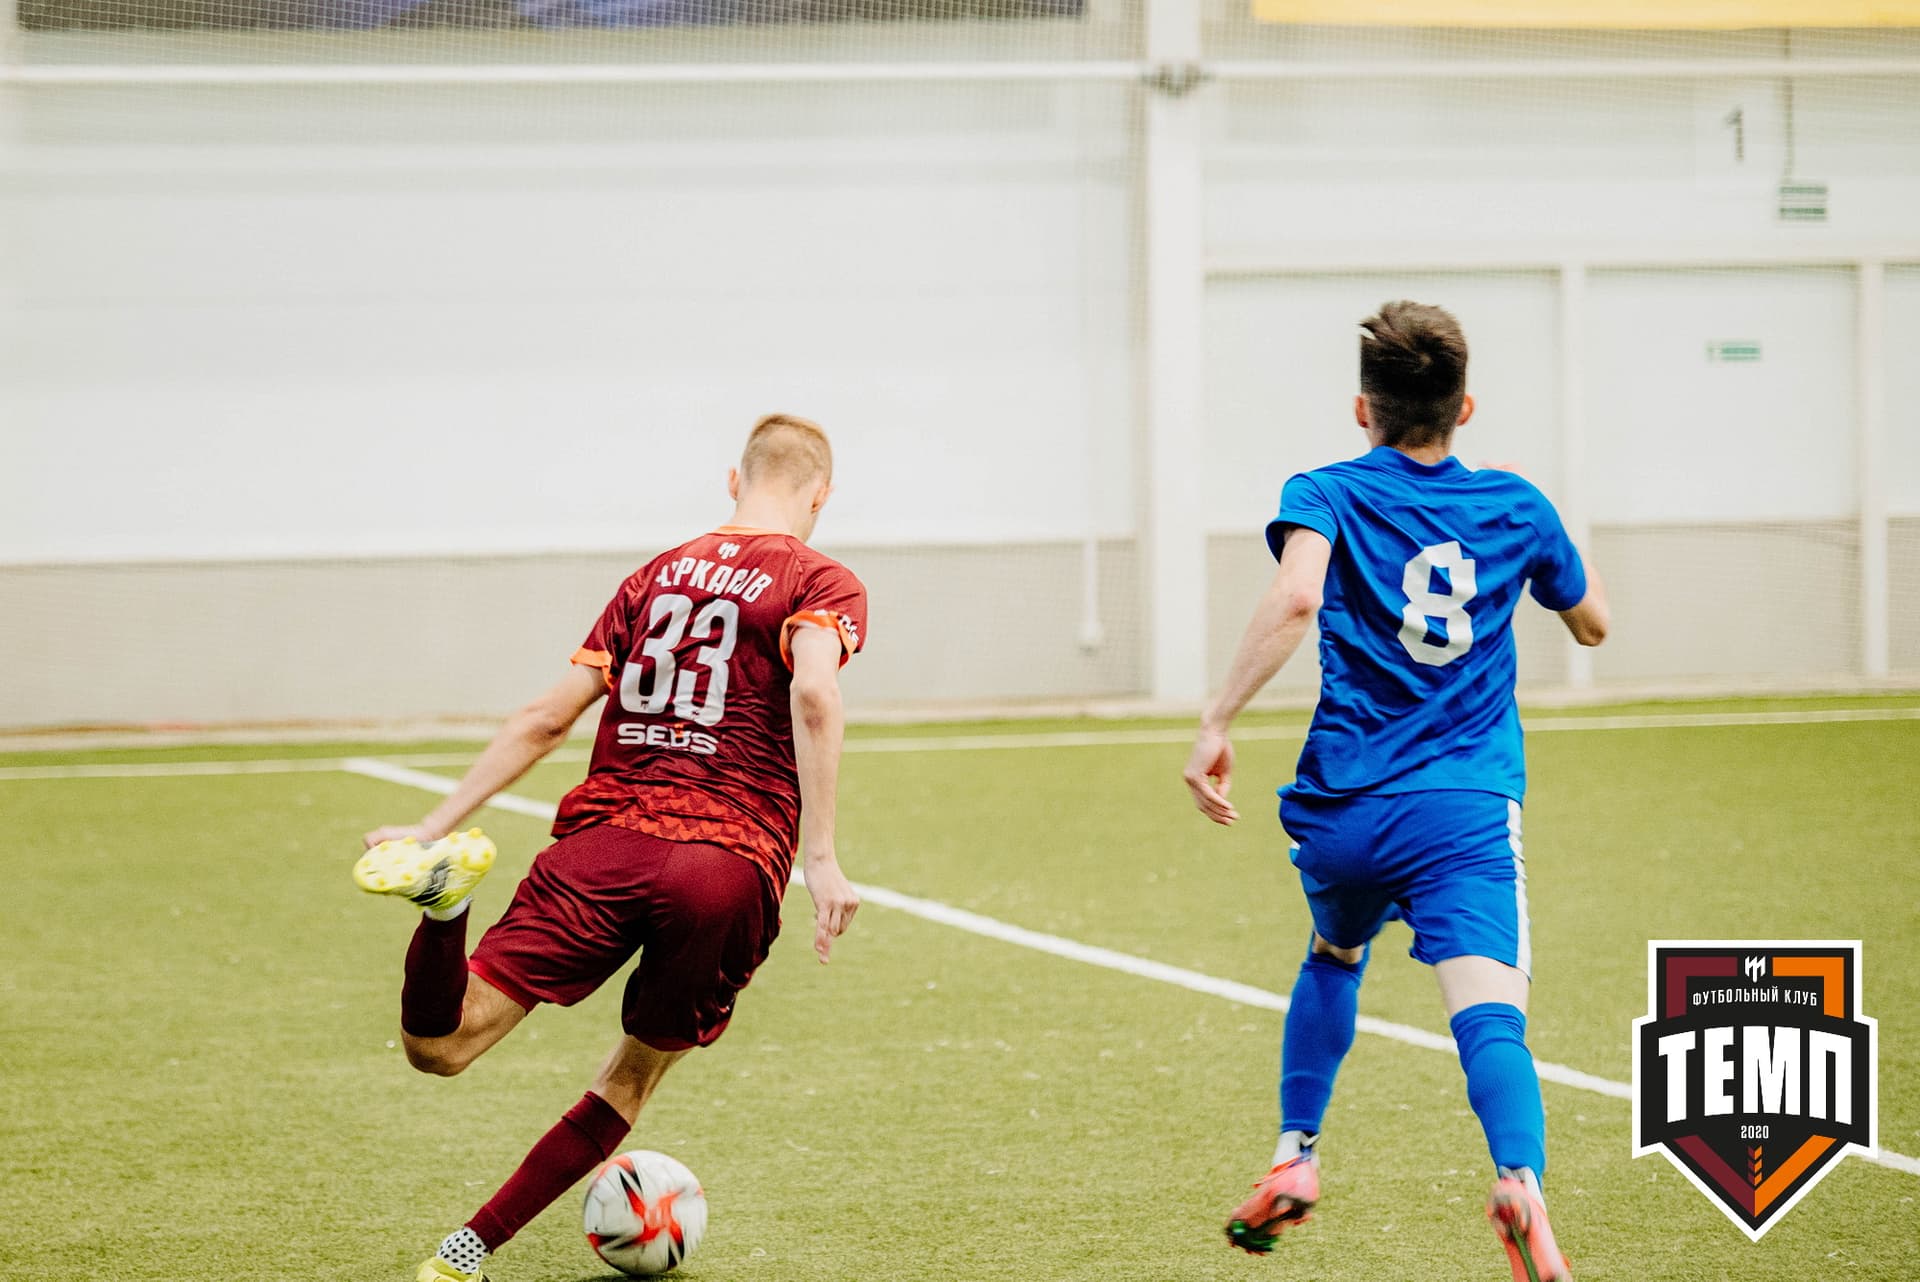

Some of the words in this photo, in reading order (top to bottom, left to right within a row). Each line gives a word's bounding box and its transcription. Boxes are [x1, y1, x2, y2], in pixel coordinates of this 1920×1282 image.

[1724, 103, 1745, 161] 1
[620, 593, 739, 727] 33
[1397, 541, 1478, 667] 8
